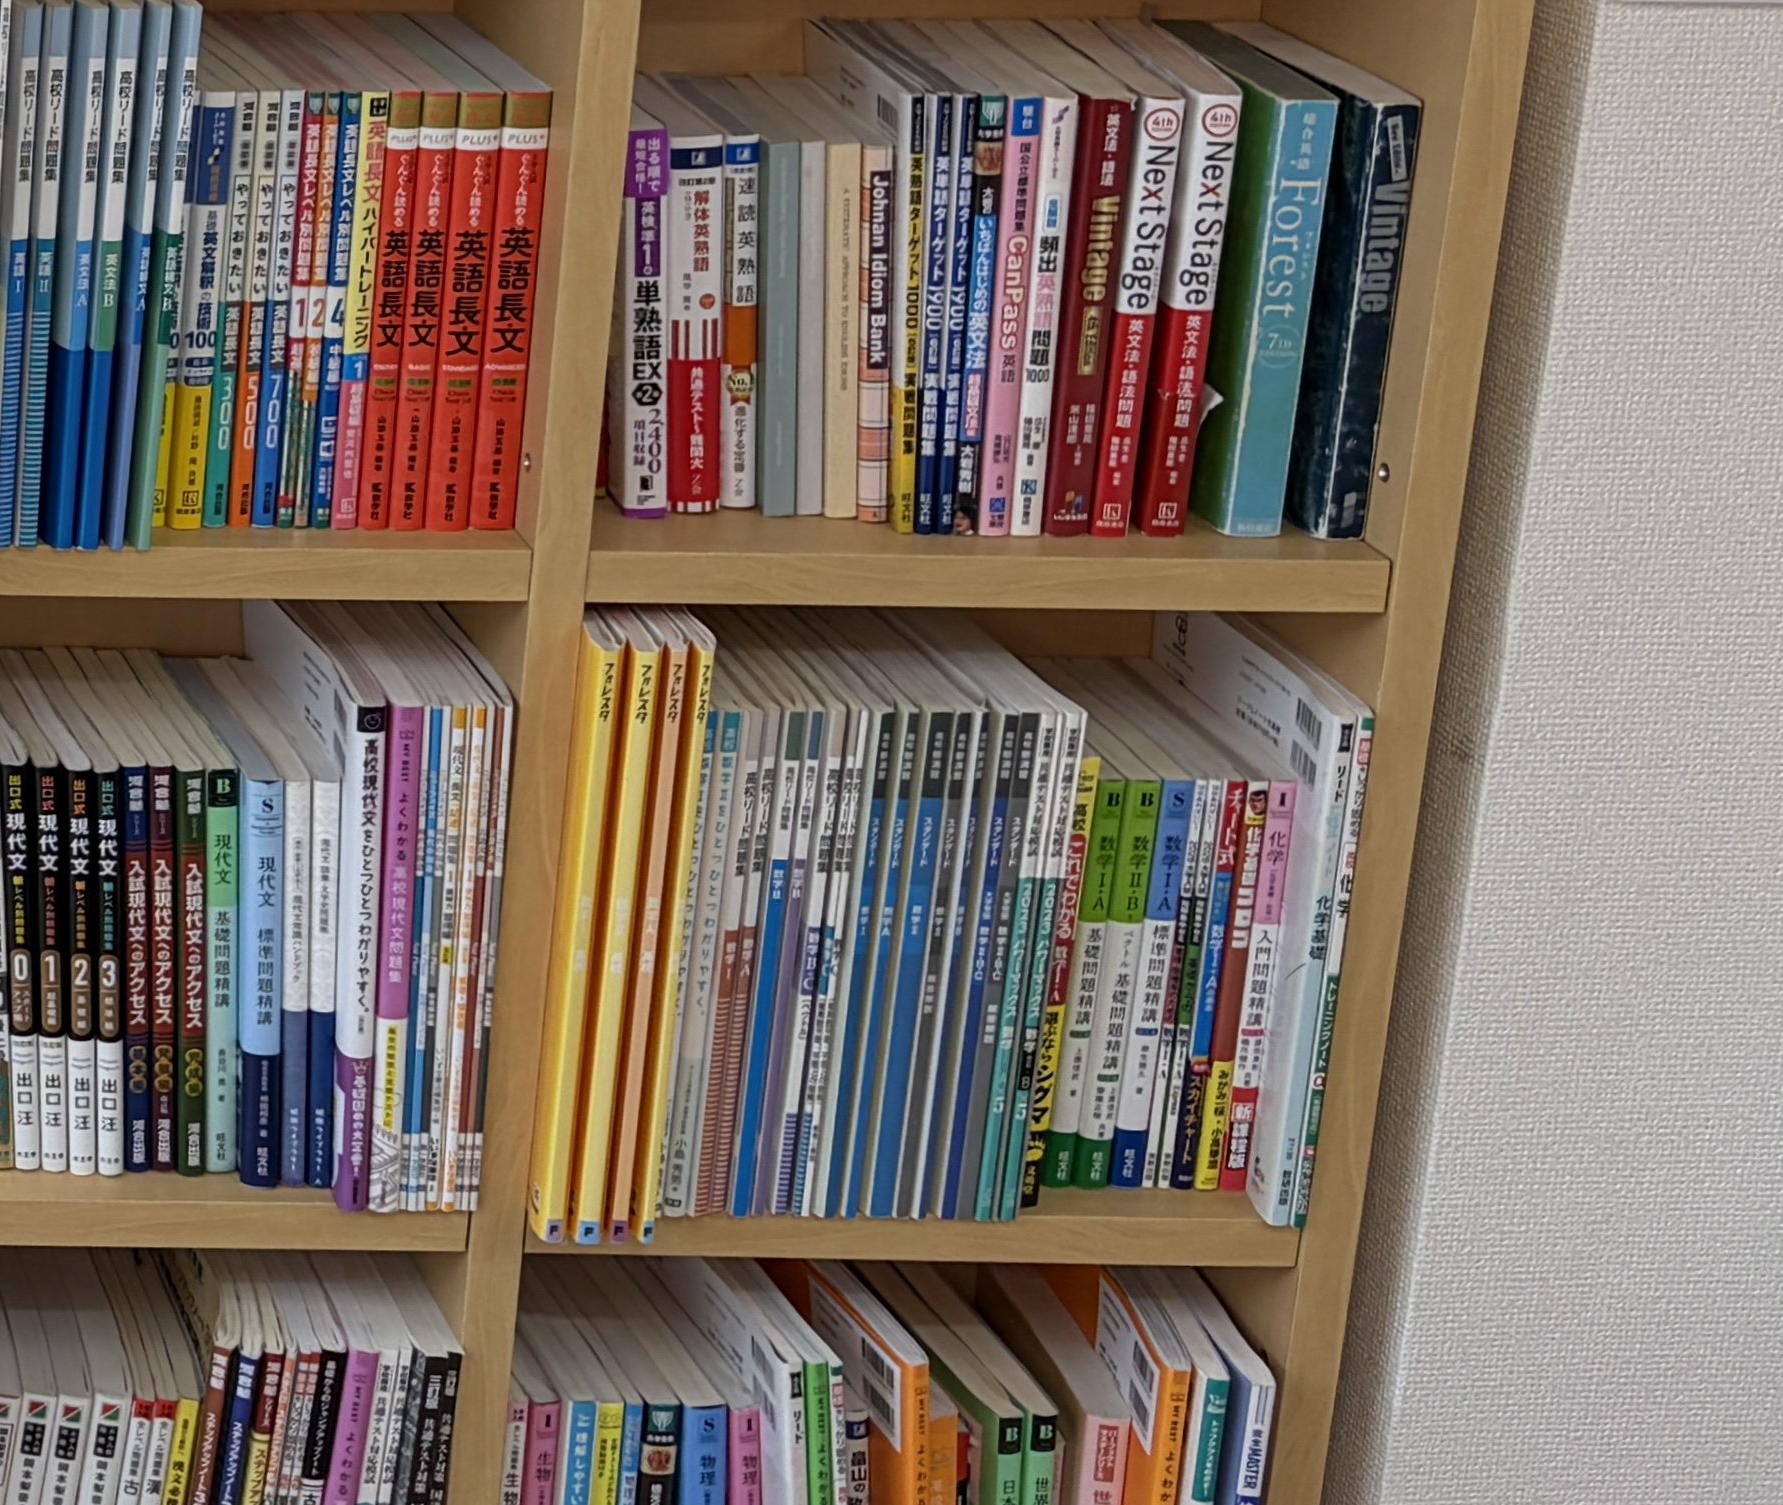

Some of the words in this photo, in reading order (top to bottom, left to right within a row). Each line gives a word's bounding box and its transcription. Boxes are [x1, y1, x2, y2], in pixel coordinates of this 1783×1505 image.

[1151, 115, 1174, 130] 4th
[648, 137, 660, 192] 出る順で
[1141, 145, 1177, 217] Next
[1197, 141, 1234, 212] Next
[229, 183, 249, 295] やっておきたい
[693, 191, 710, 272] 解体英熟語
[737, 176, 756, 305] 速読英熟語
[1038, 236, 1060, 273] 頻出
[1081, 195, 1121, 302] Vintage
[1121, 221, 1167, 310] Stage
[1179, 217, 1224, 306] Stage
[1262, 176, 1323, 318] Forest
[1359, 180, 1412, 314] Vintage
[352, 207, 382, 349] ハイパートレーニング
[377, 230, 410, 348] 英語長文
[407, 230, 445, 349] 英語長文
[870, 258, 888, 308] Idiom
[1000, 234, 1030, 350] CanPass
[184, 331, 217, 349] 100
[632, 279, 662, 382] 単熟語EX
[869, 314, 886, 364] Bank
[1030, 330, 1051, 366] 問題
[1001, 354, 1016, 383] 英語
[1114, 319, 1145, 428] 英文法・語法問題
[1173, 315, 1202, 428] 英文法・語法問題
[218, 375, 233, 451] 300
[243, 374, 259, 449] 500
[265, 374, 281, 449] 700
[8, 775, 22, 810] 出口式
[41, 775, 55, 811] 出口式
[216, 779, 231, 795] B
[261, 798, 274, 813] S
[1106, 792, 1121, 807] B
[1172, 791, 1185, 806] S
[213, 834, 233, 886] 現代文
[397, 792, 410, 861] よくわかる
[1267, 831, 1286, 864] 化学
[257, 856, 277, 908] 現代文
[356, 739, 380, 1014] 高校現代文をひとつひとつわかりやすく。
[128, 858, 147, 1026] 入試現代文へのアクセス
[154, 858, 174, 1025] 入試現代文へのアクセス
[214, 911, 231, 1009] 基礎問題精講
[1309, 896, 1331, 961] 化学基礎
[13, 954, 28, 981] 0
[256, 928, 275, 1026] 標準問題精講
[1075, 928, 1102, 1027] 基礎問題精講
[1141, 925, 1171, 1026] 標準問題精講
[1239, 929, 1273, 1027] 入門問題精講
[16, 1072, 33, 1127] 出口汪
[45, 1073, 62, 1127] 出口汪
[1031, 1065, 1055, 1124] シグマ
[535, 1452, 552, 1483] 生物
[699, 1455, 716, 1484] 物理
[742, 1456, 758, 1484] 物理
